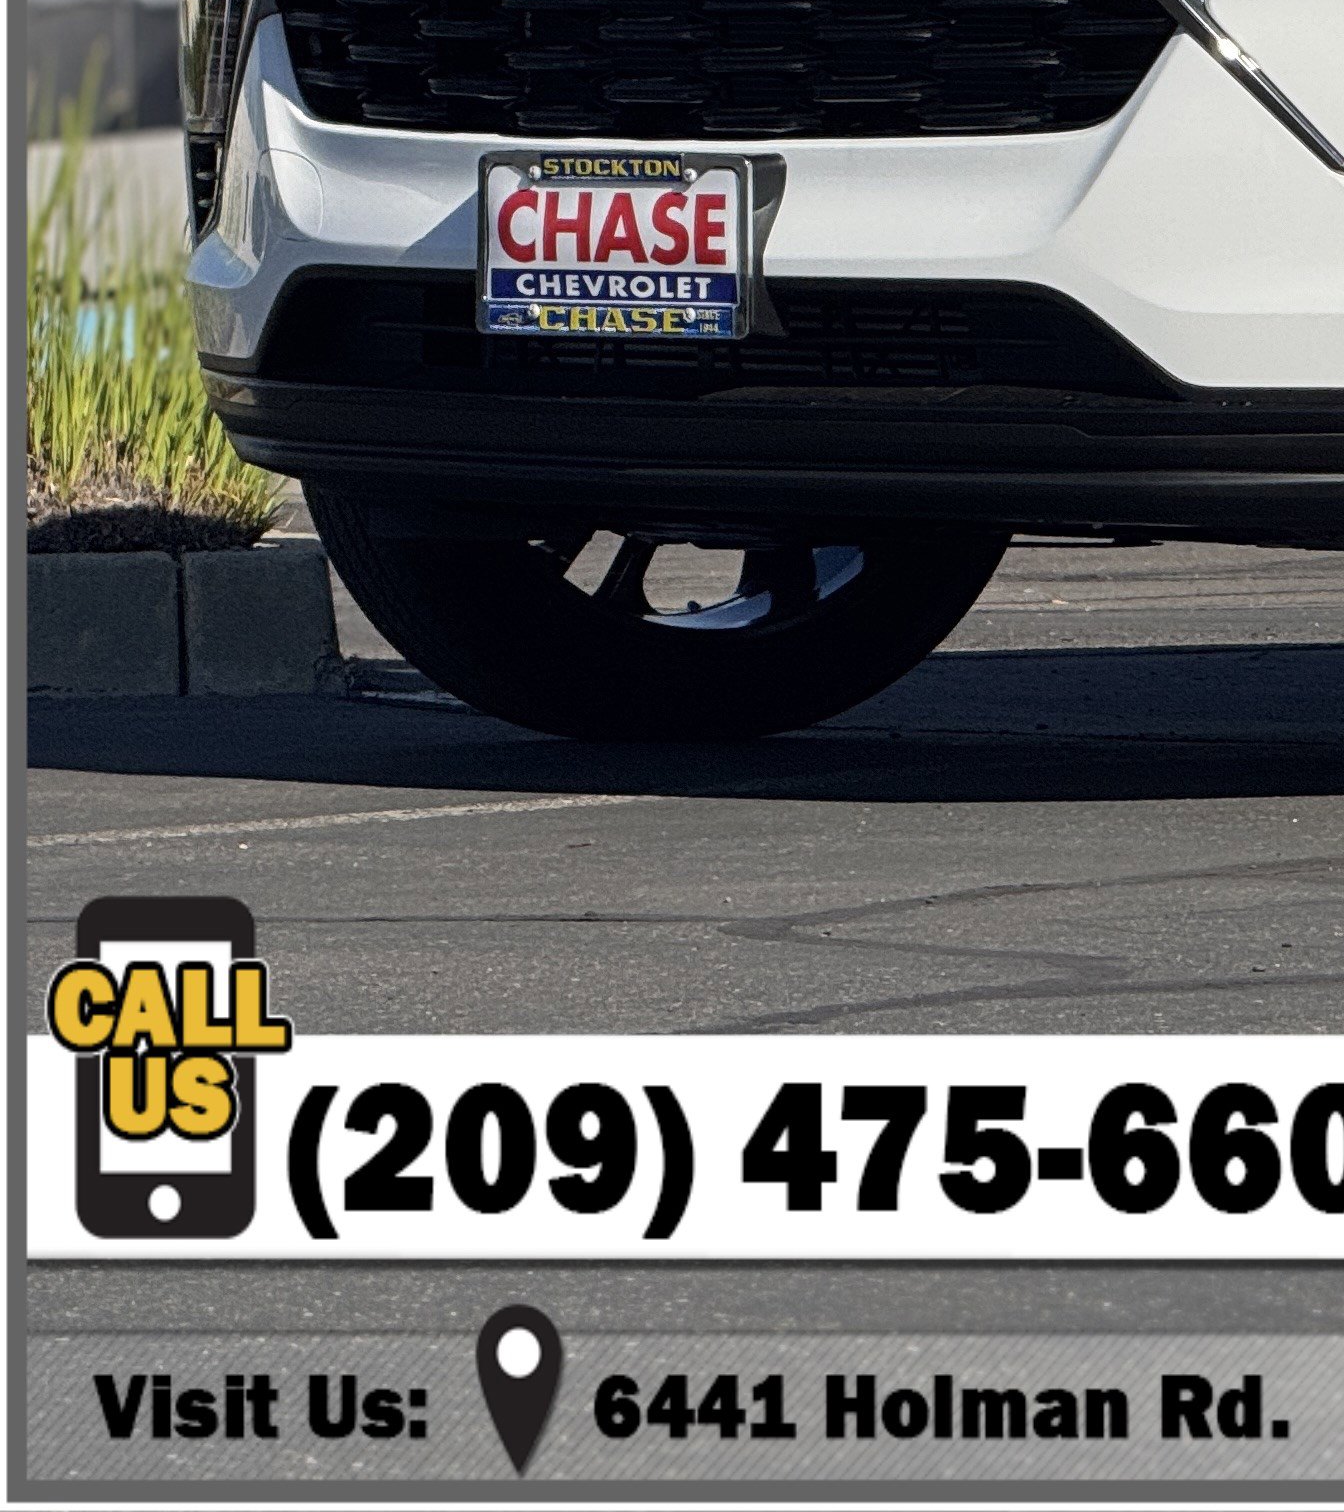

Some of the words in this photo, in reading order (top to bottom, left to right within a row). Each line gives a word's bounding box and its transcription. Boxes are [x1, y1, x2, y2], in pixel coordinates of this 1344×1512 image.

[543, 157, 680, 178] STOCKTON
[498, 188, 727, 266] CHASE
[516, 273, 711, 299] CHEVROLET
[540, 305, 687, 333] CHASE
